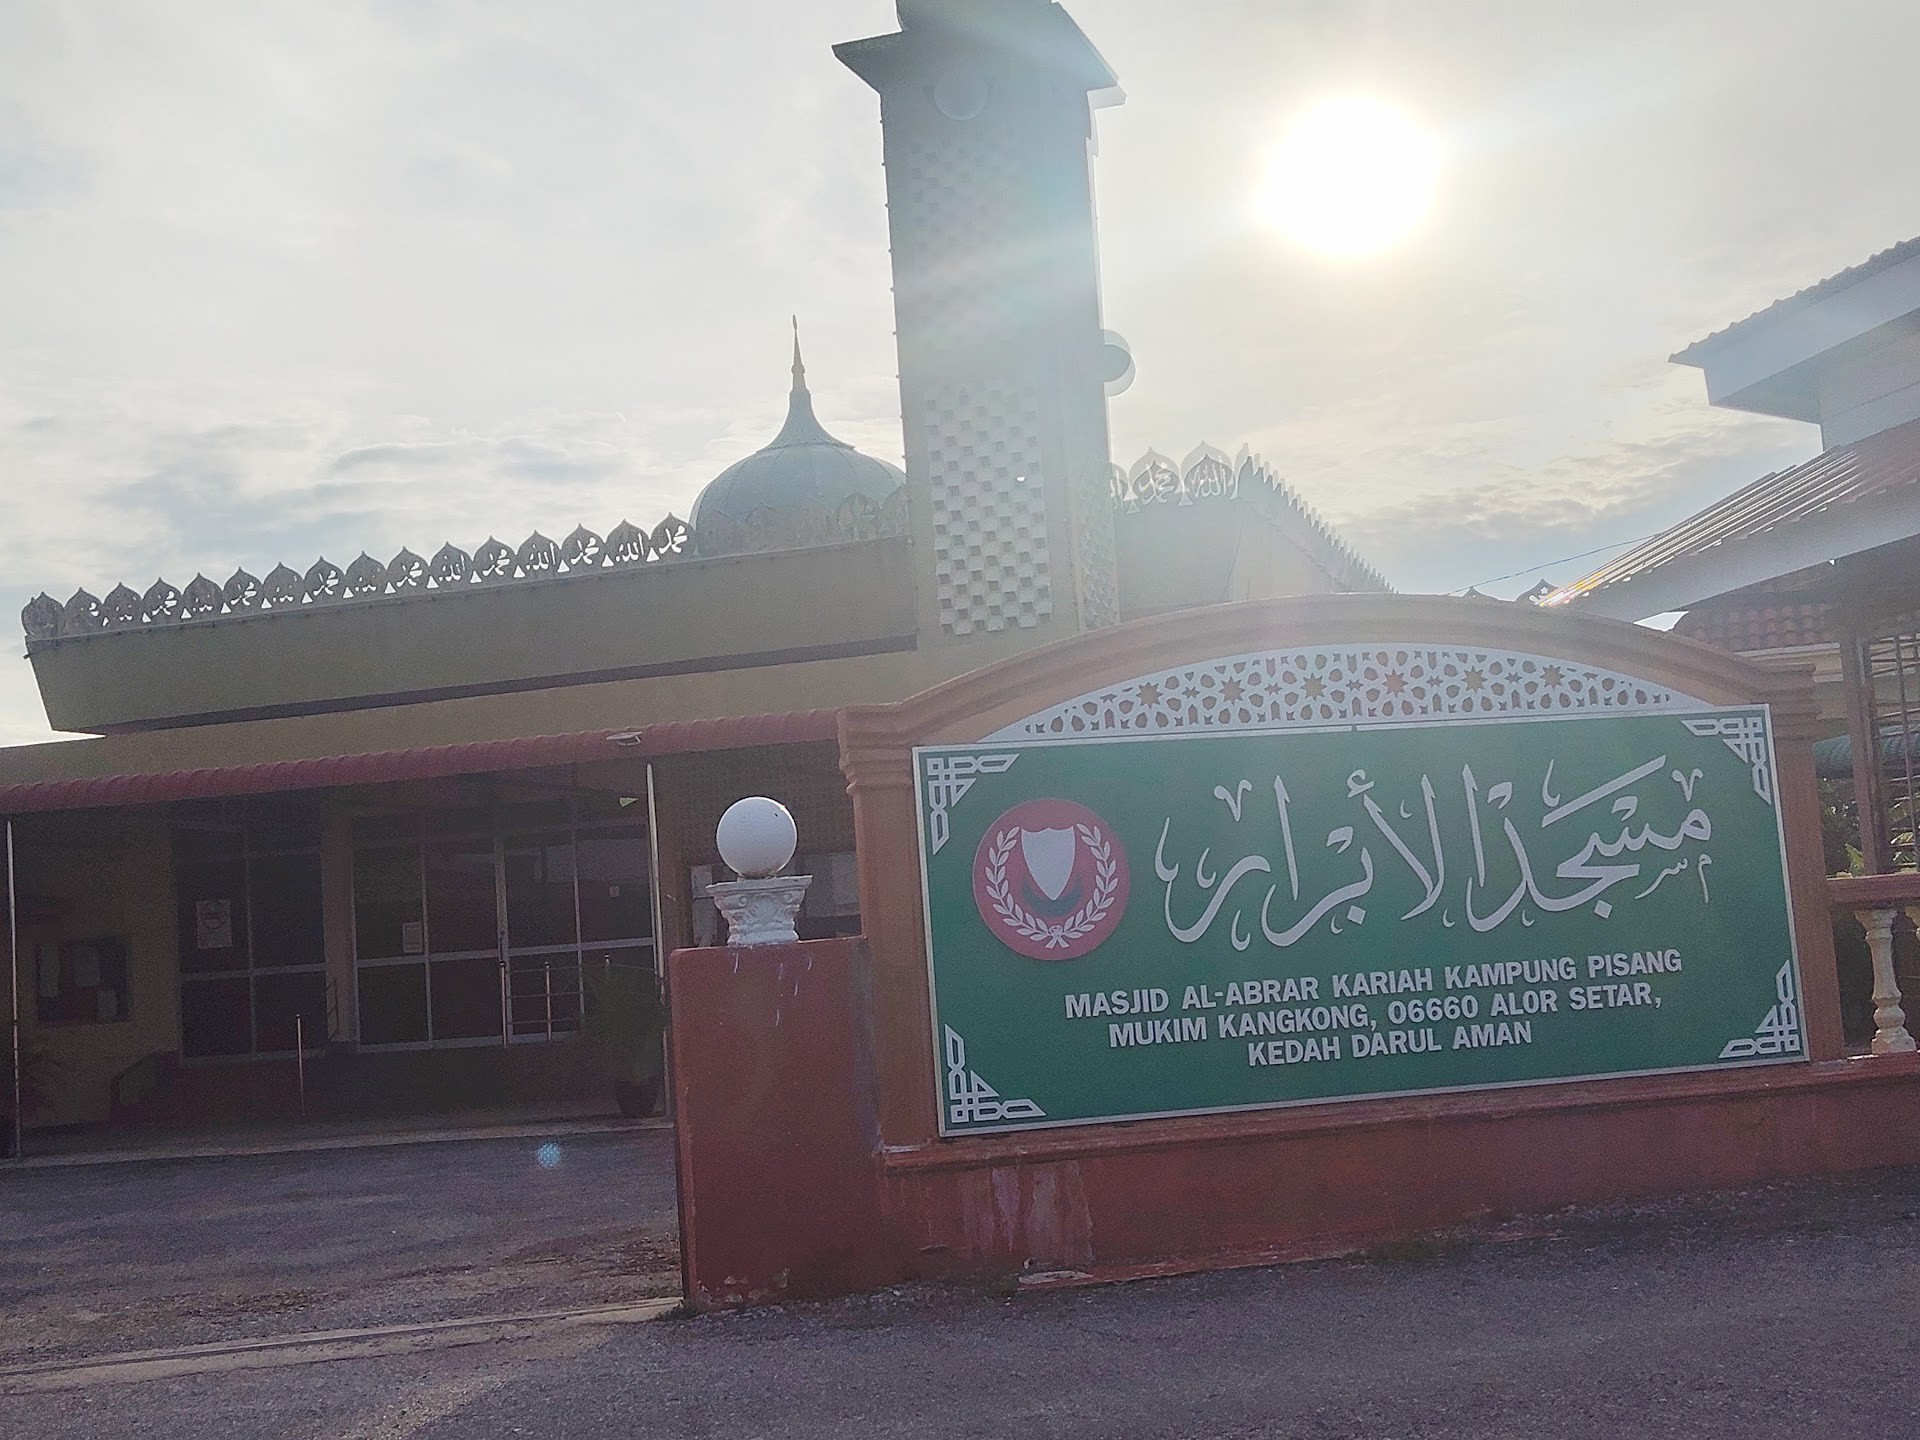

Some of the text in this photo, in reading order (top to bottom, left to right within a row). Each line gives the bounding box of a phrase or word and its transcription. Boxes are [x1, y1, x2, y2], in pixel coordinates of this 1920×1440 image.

[1064, 949, 1682, 1019] MASJID AL-ABRAR KARIAH KAMPUNG PISANG
[1109, 981, 1662, 1048] MUKIM KANGKONG, 06660 ALOR SETAR,
[1247, 1020, 1533, 1067] KEDAH DARUL AMAN
